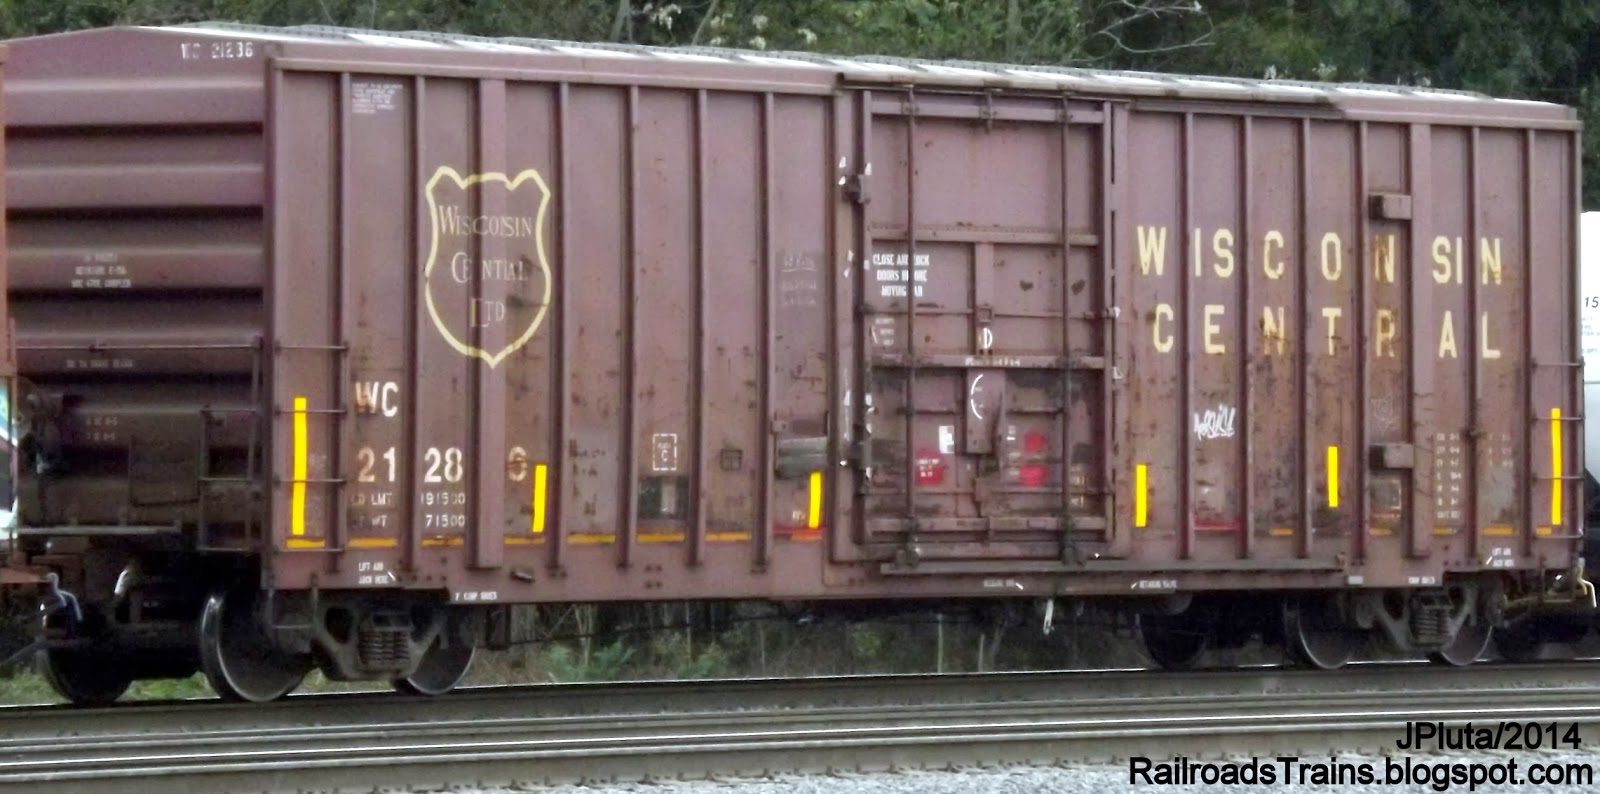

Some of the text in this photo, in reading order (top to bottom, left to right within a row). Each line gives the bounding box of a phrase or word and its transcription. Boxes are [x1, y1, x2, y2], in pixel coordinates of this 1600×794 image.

[873, 254, 895, 266] CLOSE
[1137, 225, 1502, 285] WISCONSIN
[1153, 303, 1501, 358] CENTRAL
[355, 381, 399, 417] WC
